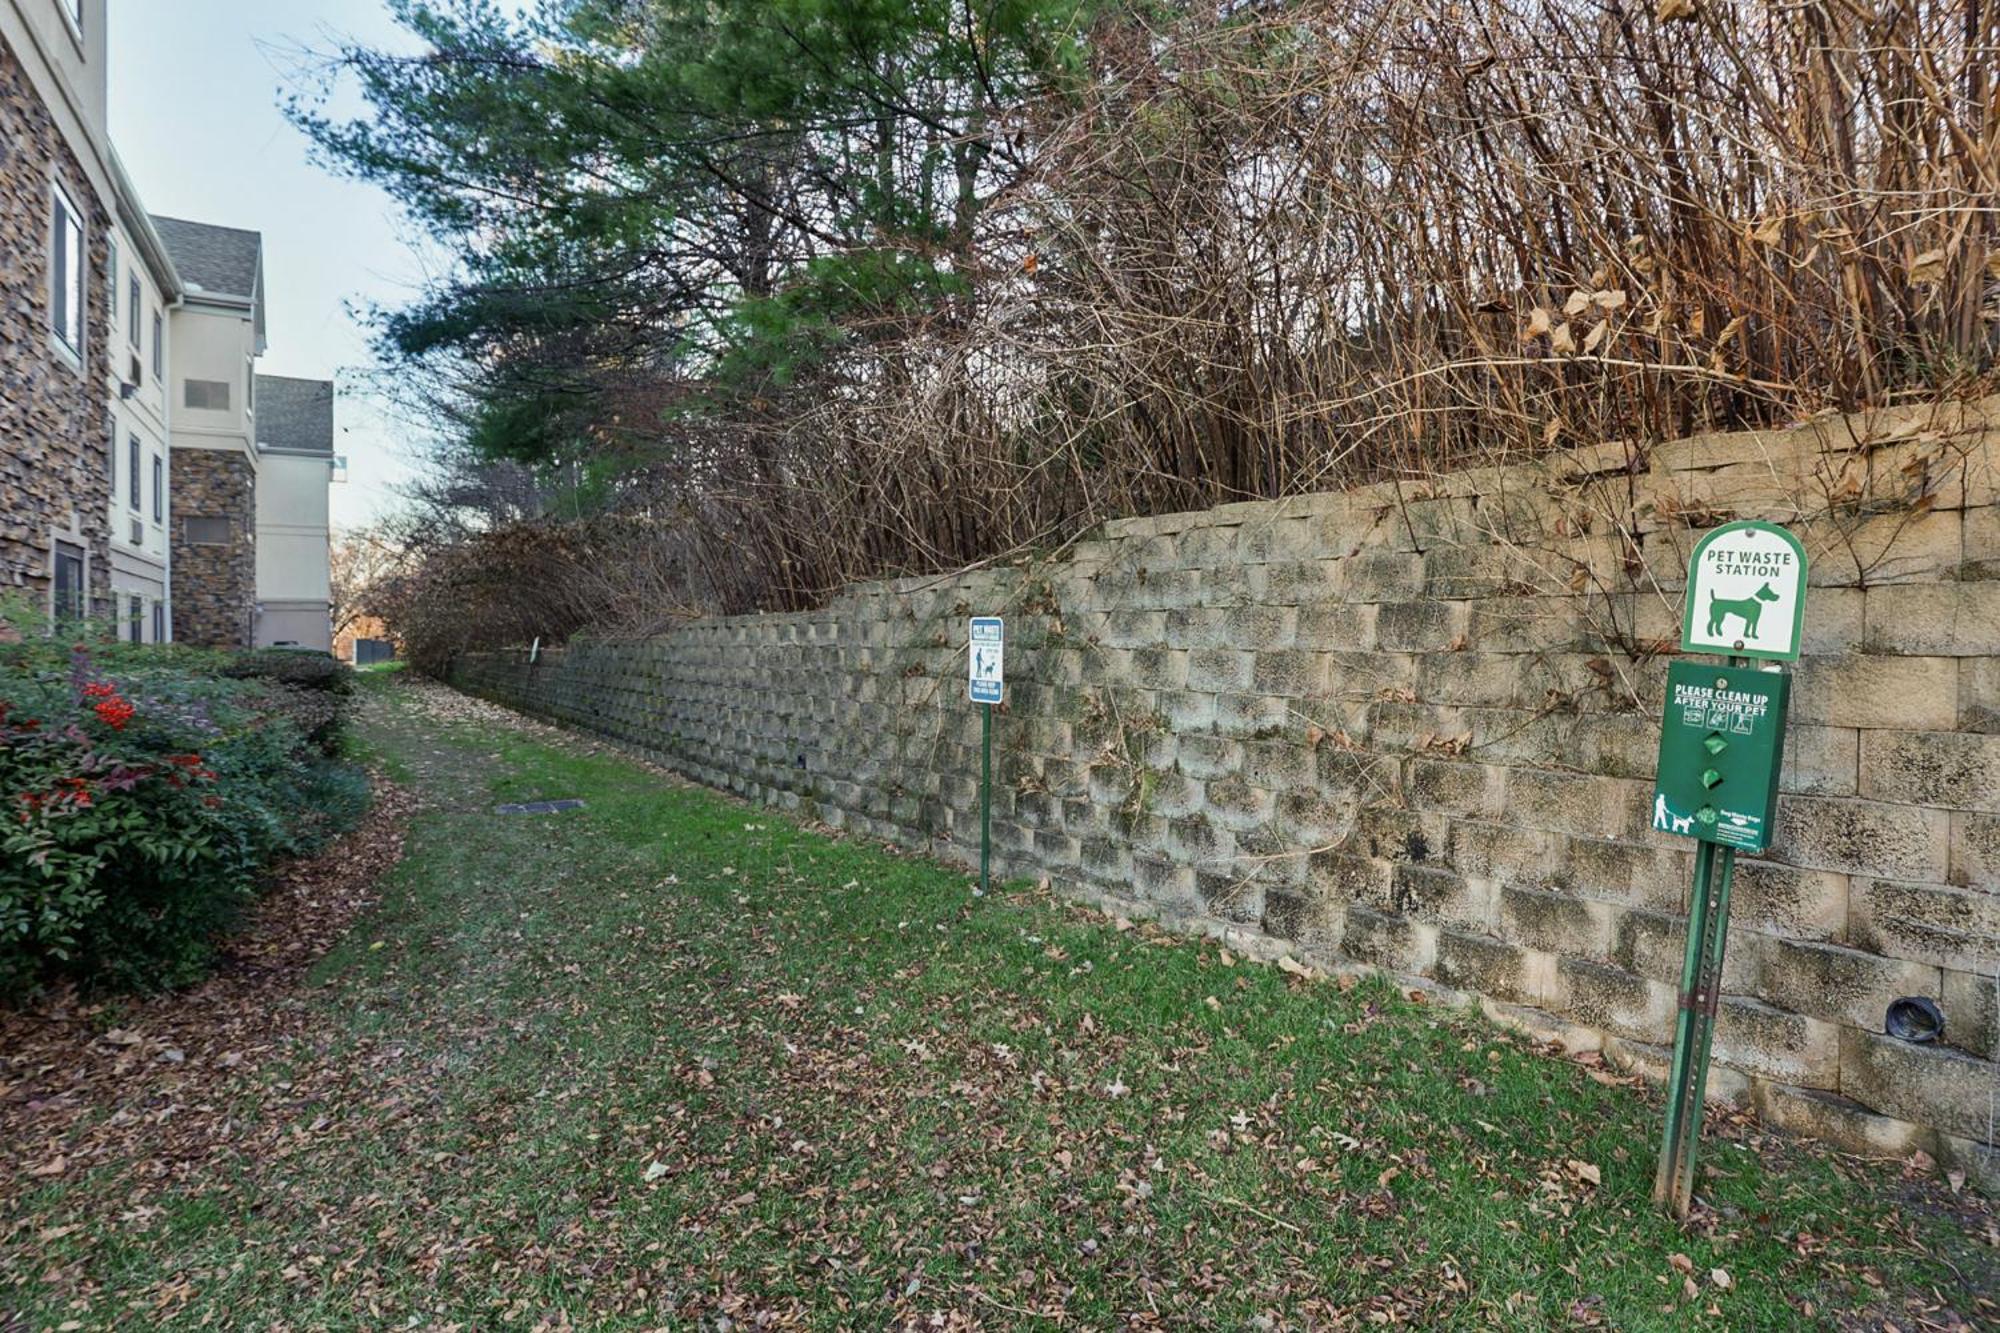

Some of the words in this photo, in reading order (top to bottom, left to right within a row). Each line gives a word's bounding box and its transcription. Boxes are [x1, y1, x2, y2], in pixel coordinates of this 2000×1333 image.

[1707, 549, 1735, 562] PET
[1739, 551, 1791, 565] WASTE
[1715, 563, 1780, 577] STATION
[1675, 684, 1714, 698] PLEASE
[1715, 690, 1751, 704] CLEAN
[1752, 694, 1769, 706] UP
[1674, 697, 1709, 709] AFTER
[1711, 700, 1742, 713] YOUR
[1745, 706, 1768, 717] PET
